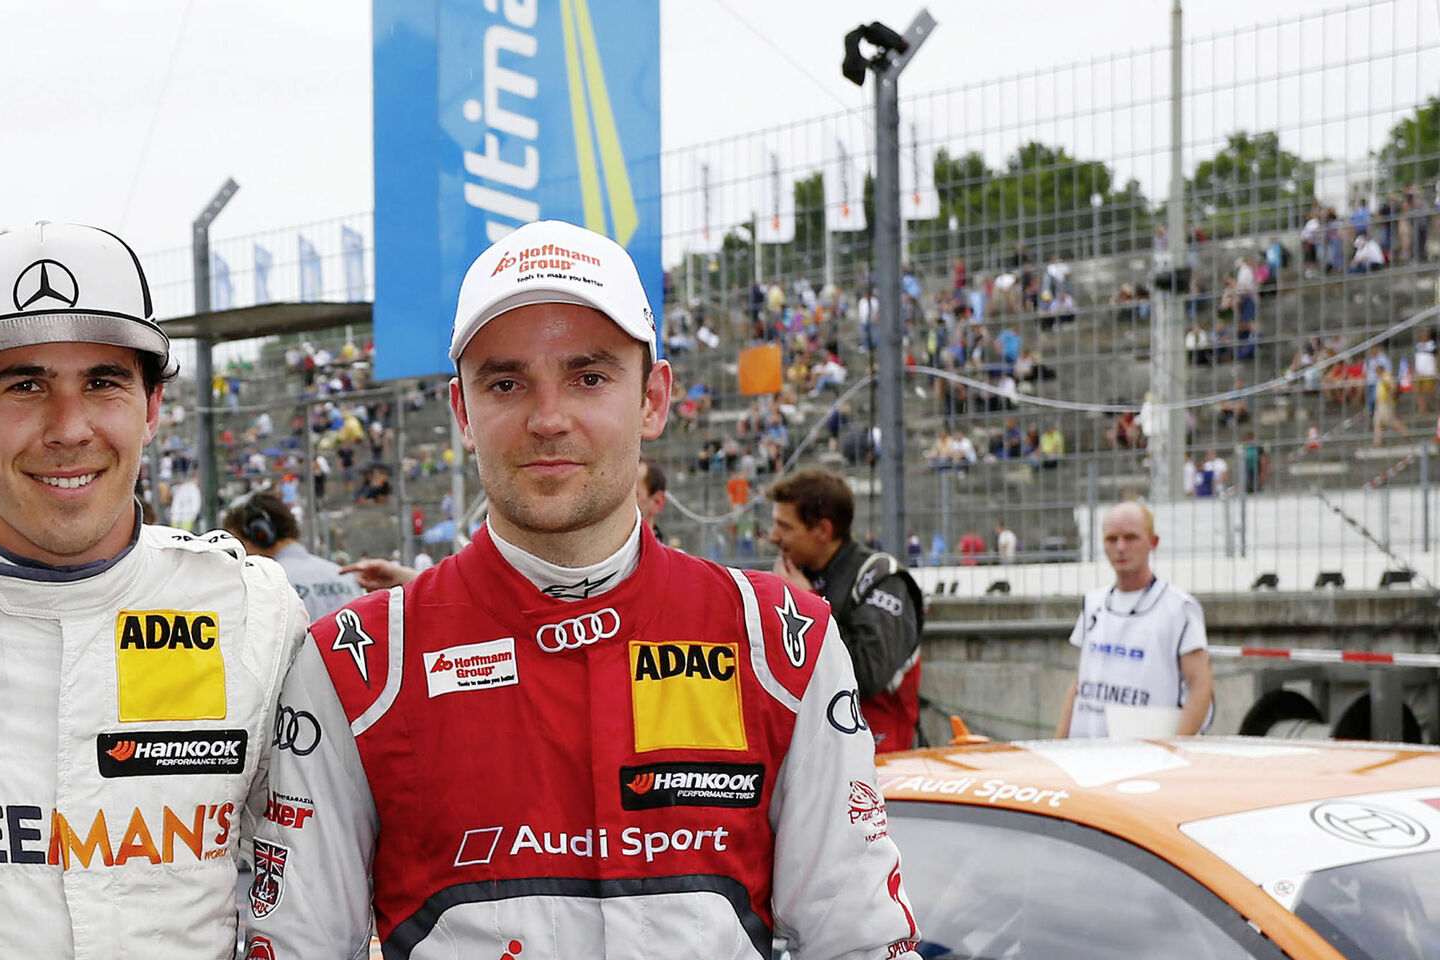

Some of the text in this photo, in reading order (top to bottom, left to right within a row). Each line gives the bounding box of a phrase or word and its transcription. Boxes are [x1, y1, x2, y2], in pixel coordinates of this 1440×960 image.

[518, 244, 601, 267] Hoffmann
[120, 615, 216, 650] ADAC
[454, 651, 512, 669] Hoffmann
[635, 644, 735, 682] ADAC
[156, 758, 217, 766] PERFORMANCE
[677, 789, 755, 800] PERFORMANCE TIRES
[896, 775, 1069, 807] Audi Sport
[510, 825, 729, 862] Audi Sport
